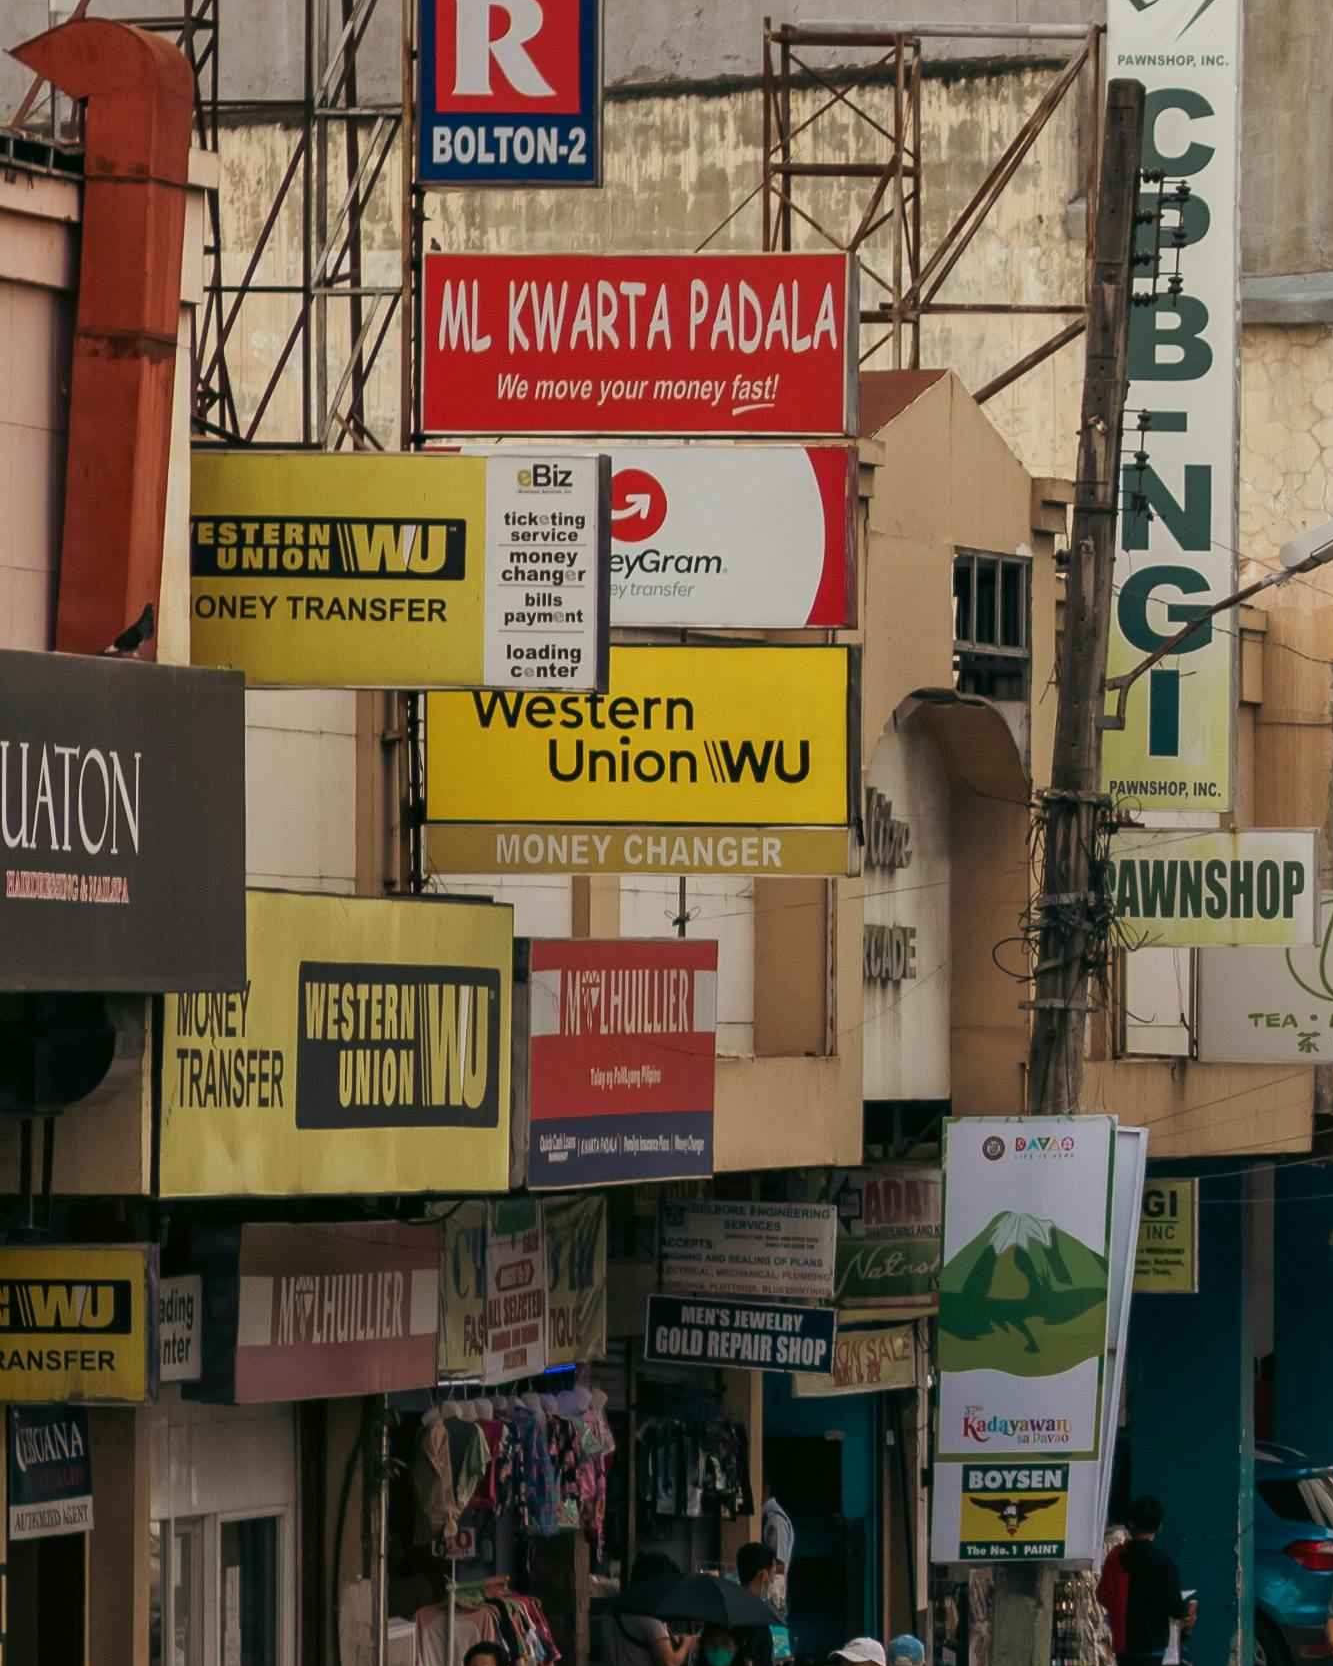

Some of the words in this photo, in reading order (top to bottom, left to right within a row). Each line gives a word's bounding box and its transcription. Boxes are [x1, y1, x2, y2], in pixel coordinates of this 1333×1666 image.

[1117, 54, 1196, 68] PAWNSHOP,
[1201, 54, 1229, 67] INC.
[432, 127, 586, 166] BOLTON-2
[438, 278, 491, 353] ML
[508, 279, 671, 354] KWARTA
[689, 278, 838, 354] PADALA
[497, 373, 528, 399] We
[534, 379, 592, 400] move
[597, 378, 648, 406] your
[653, 379, 726, 406] money
[731, 374, 780, 400] fast!
[517, 464, 573, 488] eBiz
[504, 511, 586, 529] ticketing
[191, 522, 330, 547] ESTERN
[350, 524, 447, 574] WU
[511, 528, 579, 543] service
[216, 548, 330, 572] UNION
[509, 550, 578, 567] money
[609, 548, 723, 578] eyGram
[501, 567, 586, 585] changer
[630, 581, 695, 598] transfer
[192, 595, 278, 620] ONEY
[286, 596, 447, 623] TRANSFER
[524, 593, 563, 607] bills
[504, 609, 584, 626] payment
[506, 644, 582, 664] loading
[510, 663, 578, 678] center
[471, 691, 694, 730] Western
[549, 736, 698, 783] Union
[721, 740, 810, 783] WU
[1108, 780, 1188, 798] PAWNSHOP,
[1193, 780, 1222, 797] INC.
[496, 834, 612, 865] MONEY
[623, 835, 782, 867] CHANGER
[176, 981, 251, 1038] MONEY
[1248, 1013, 1300, 1028] TEA
[304, 981, 416, 1041] WESTERN
[429, 984, 490, 1110] WU
[176, 1048, 283, 1109] TRANSFER
[338, 1049, 416, 1108] UNION
[1015, 1136, 1074, 1152] DAVAO
[1144, 1189, 1177, 1218] GI
[724, 1220, 781, 1231] SERVICES
[29, 1285, 115, 1328] WU
[160, 1288, 194, 1330] ading
[681, 1305, 730, 1327] MEN'S
[734, 1310, 803, 1332] JEWELRY
[160, 1332, 191, 1365] nter
[655, 1325, 703, 1356] GOLD
[707, 1328, 773, 1362] REPAIR
[776, 1335, 827, 1366] SHOP
[867, 1333, 910, 1363] SALE
[962, 1415, 1070, 1442] Kadayawan
[968, 1469, 1062, 1489] BOYSEN
[967, 1545, 986, 1556] The
[990, 1545, 1009, 1555] No.
[1024, 1545, 1058, 1555] PAINT
